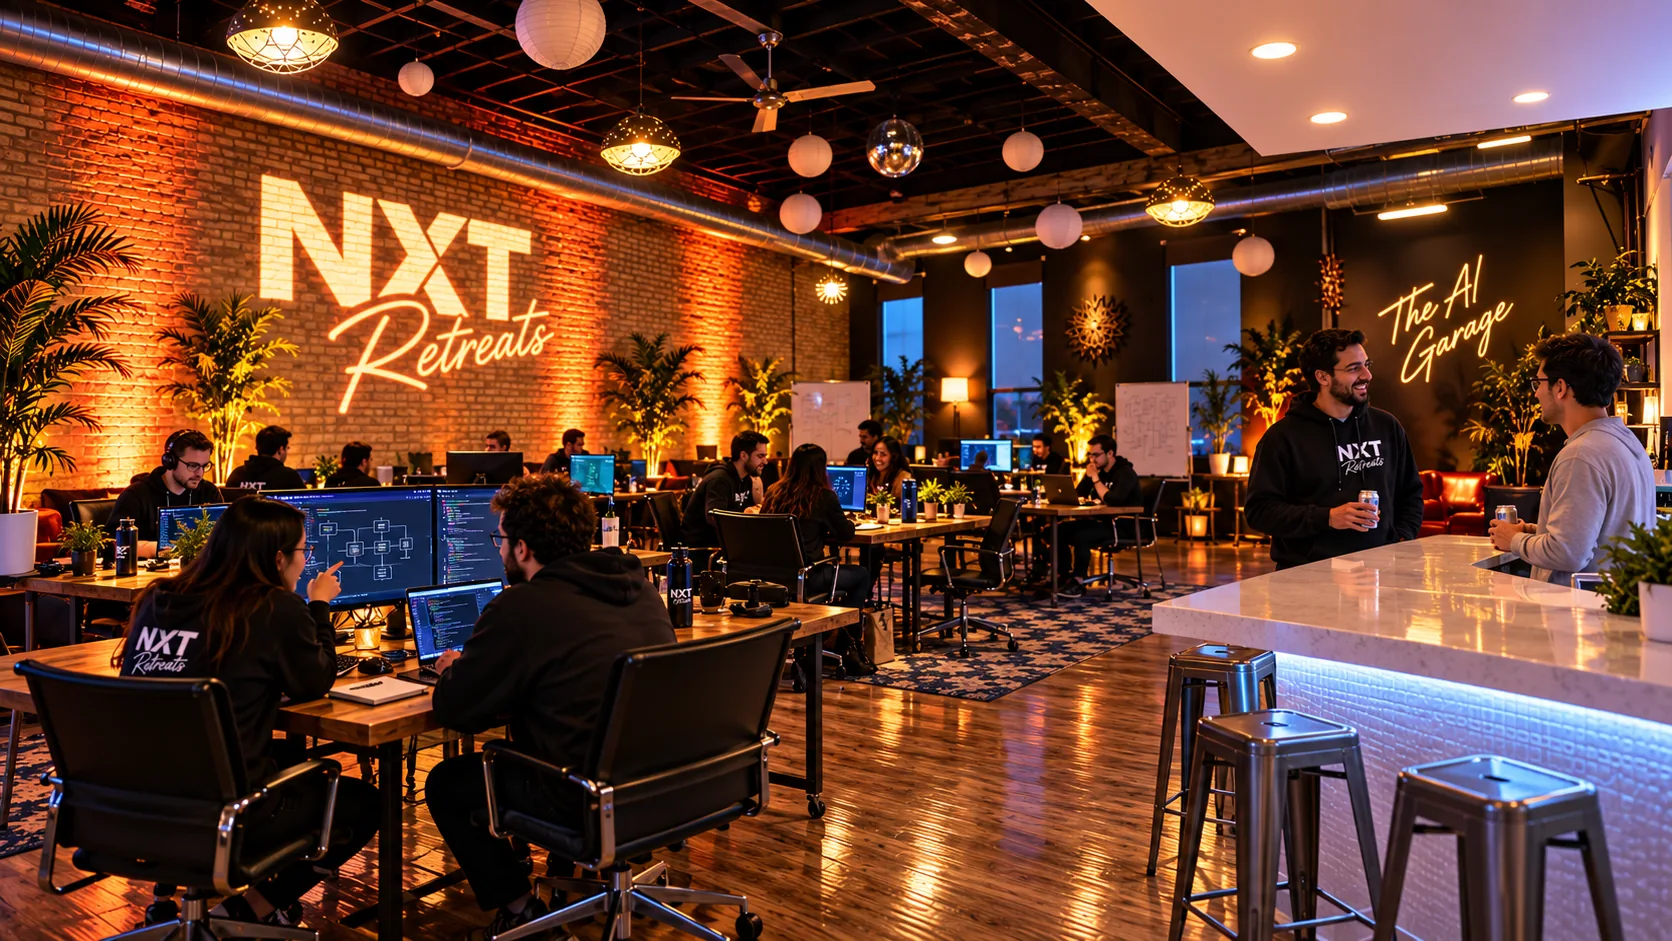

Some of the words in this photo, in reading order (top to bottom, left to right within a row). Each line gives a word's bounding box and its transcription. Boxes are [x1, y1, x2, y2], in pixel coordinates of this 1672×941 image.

[259, 174, 532, 321] NXT
[1378, 282, 1439, 345] The
[1443, 254, 1483, 319] AI
[328, 299, 555, 414] Retreats
[1401, 301, 1514, 384] Garage
[1337, 440, 1382, 462] NXT
[670, 588, 692, 598] NXT
[131, 651, 188, 675] Retreats
[135, 626, 199, 656] NXT
